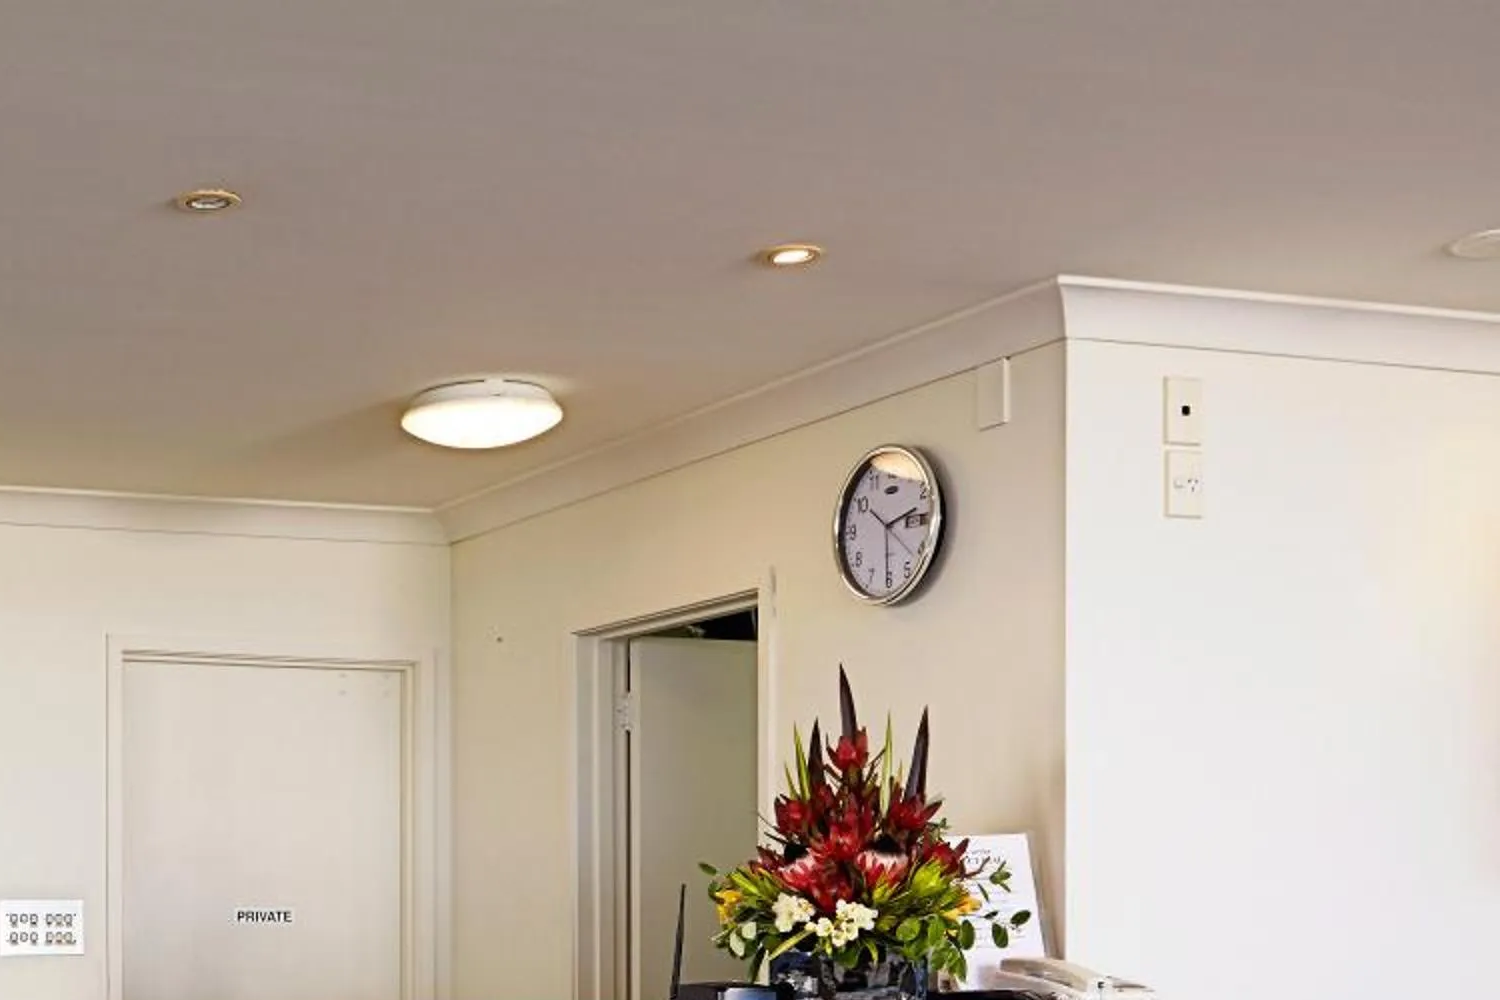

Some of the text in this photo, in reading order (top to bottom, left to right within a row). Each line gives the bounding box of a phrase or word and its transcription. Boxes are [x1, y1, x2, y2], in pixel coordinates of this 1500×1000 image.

[858, 496, 868, 513] 10
[868, 568, 875, 584] 7
[903, 561, 911, 578] 5
[237, 910, 293, 923] PRIVATE
